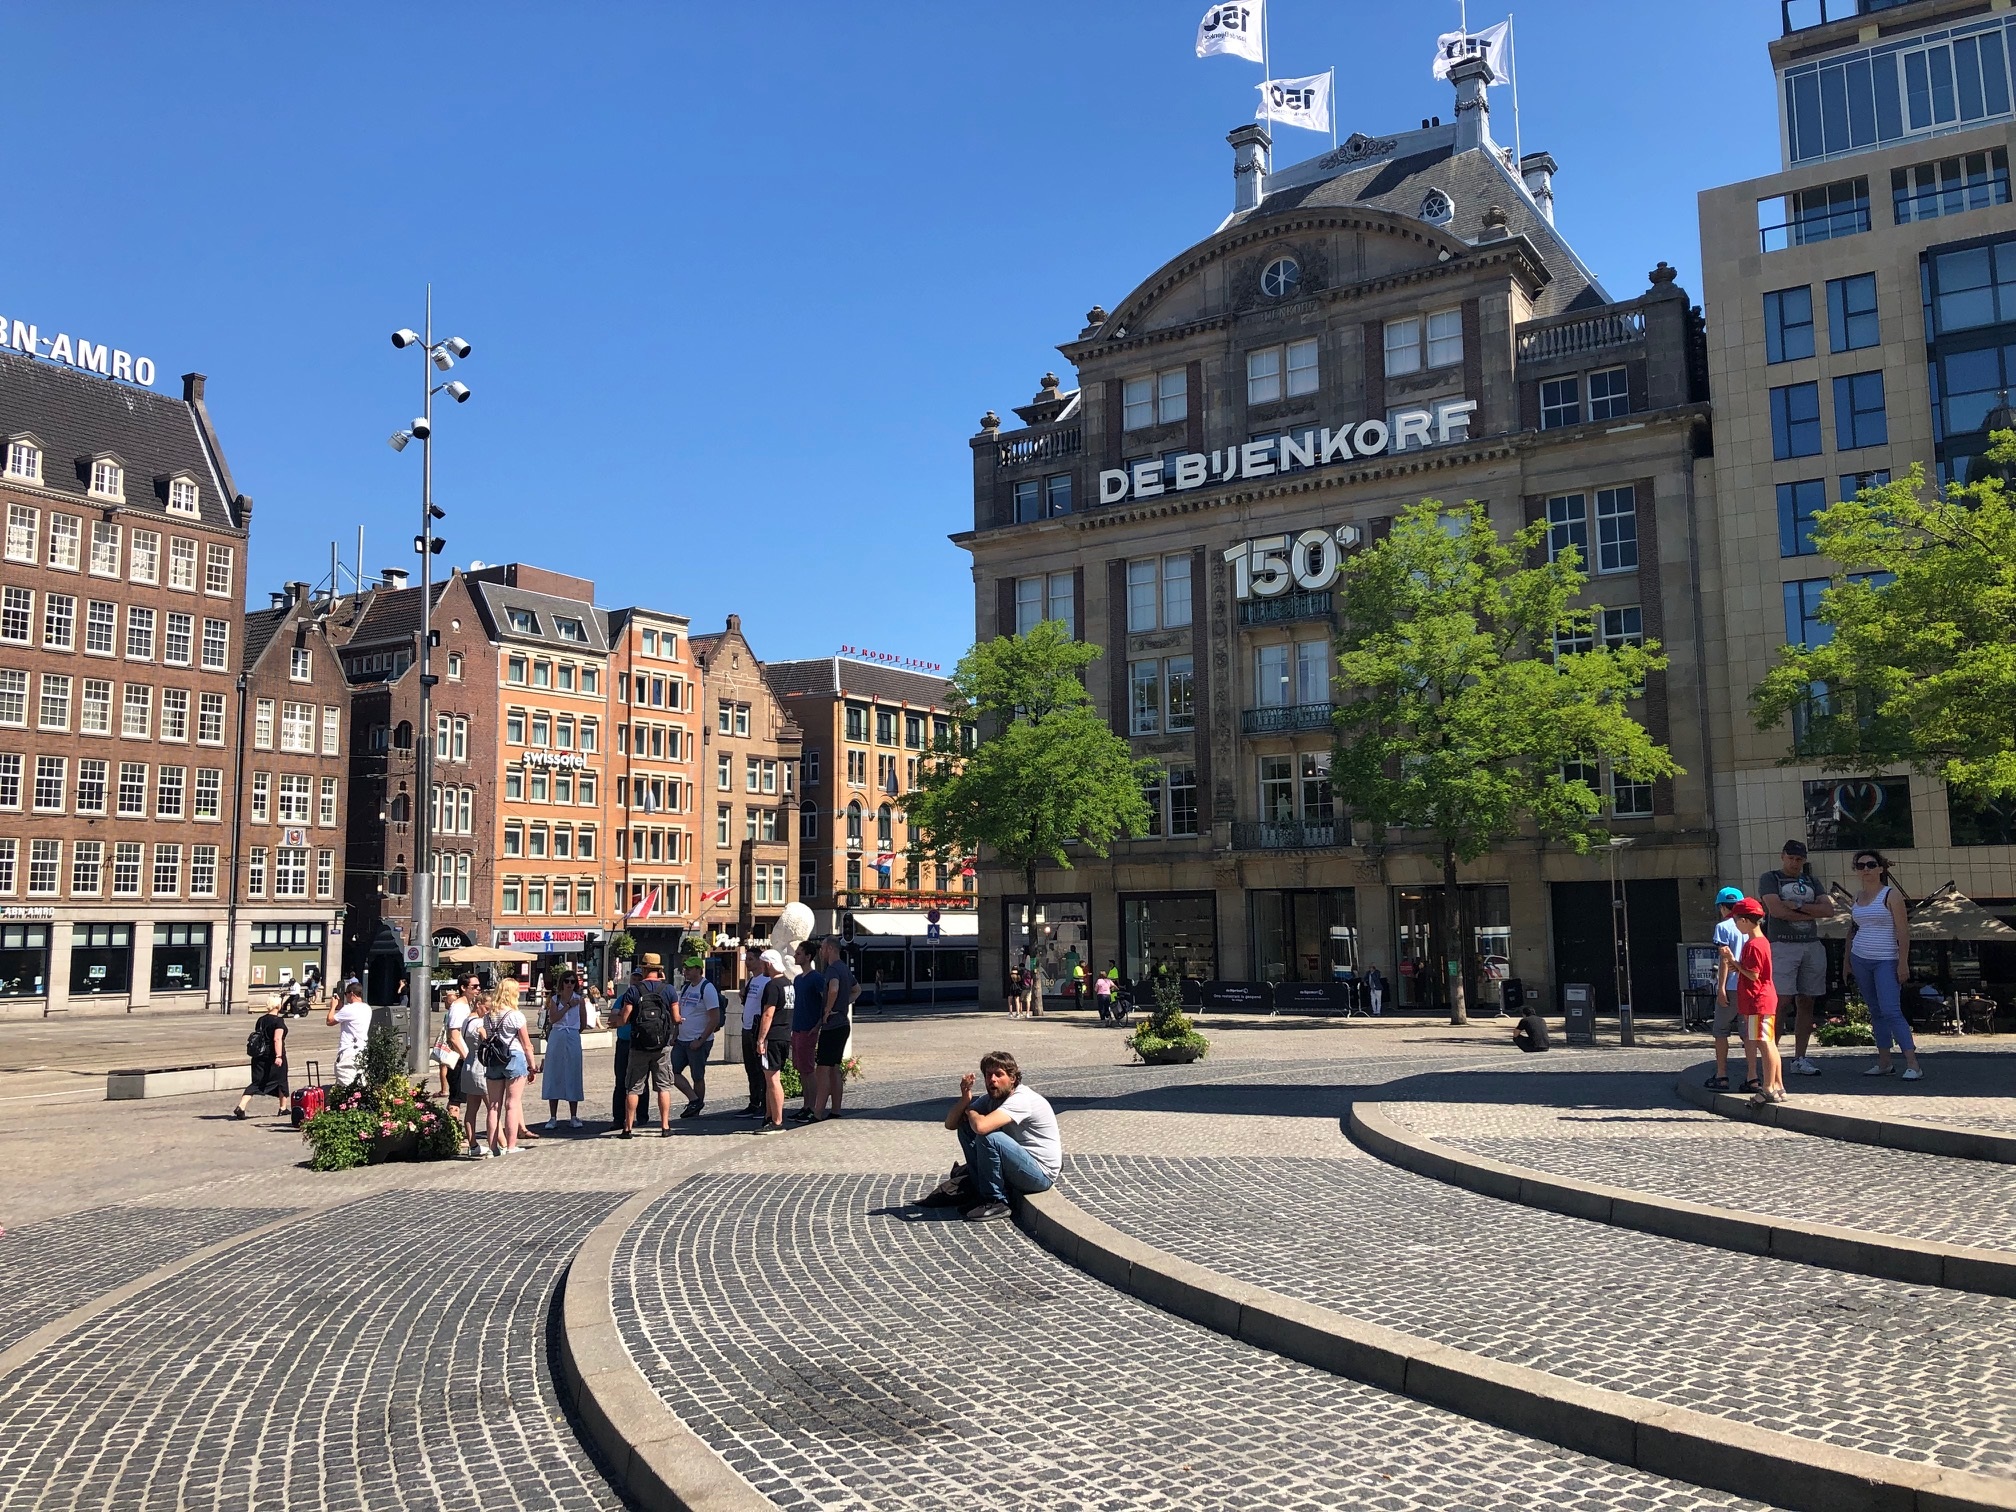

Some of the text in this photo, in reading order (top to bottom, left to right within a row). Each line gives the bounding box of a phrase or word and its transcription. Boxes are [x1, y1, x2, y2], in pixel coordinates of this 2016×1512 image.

[50, 332, 156, 387] AMRO
[1100, 400, 1477, 504] DE BIJENKORF
[842, 644, 940, 671] DE ROODE LEEUW
[431, 936, 453, 947] OYAL
[514, 930, 542, 942] TOURS
[543, 930, 551, 942] &
[552, 930, 585, 942] TICKETS
